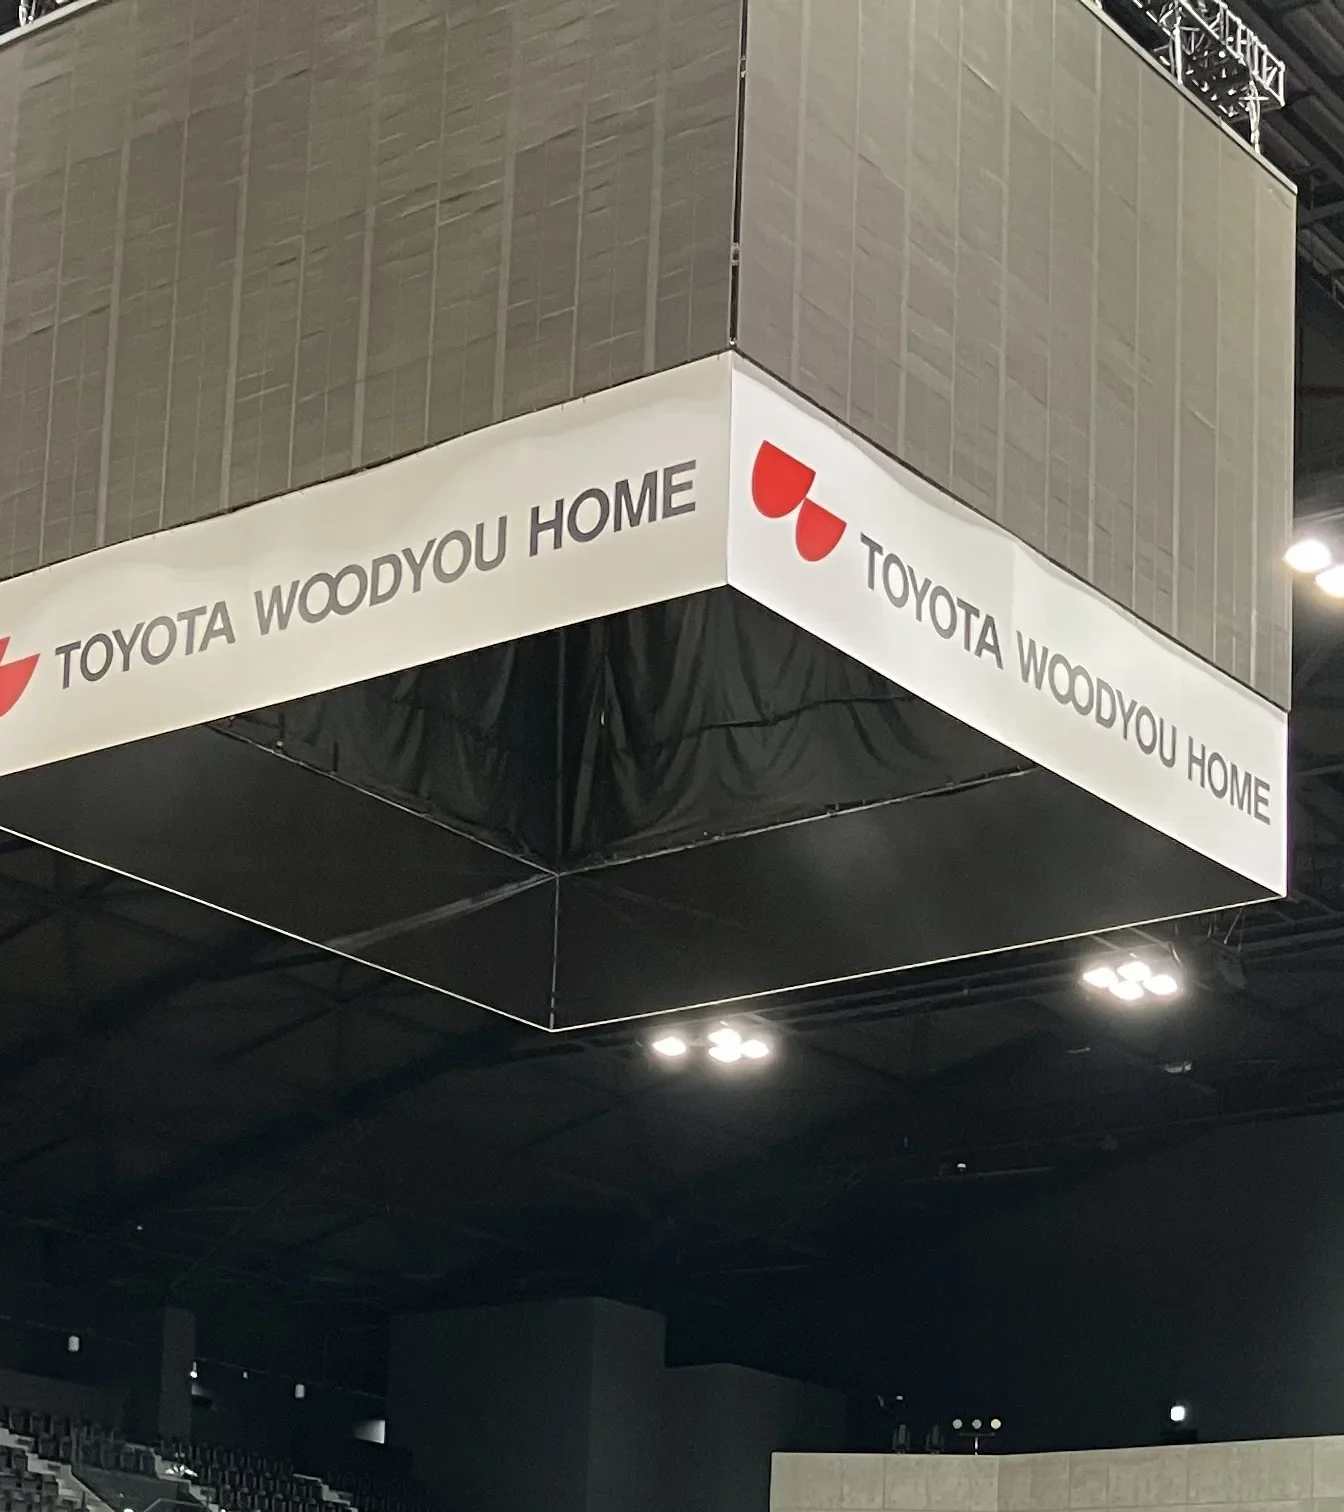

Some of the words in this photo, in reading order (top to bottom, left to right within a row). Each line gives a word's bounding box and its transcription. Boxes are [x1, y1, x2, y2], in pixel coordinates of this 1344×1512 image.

[55, 600, 235, 690] TOYOTA
[254, 515, 508, 635] WOODYOU
[530, 459, 697, 557] HOME
[860, 533, 1004, 670] TOYOTA
[1017, 630, 1177, 767] WOODYOU
[1188, 736, 1271, 825] HOME
